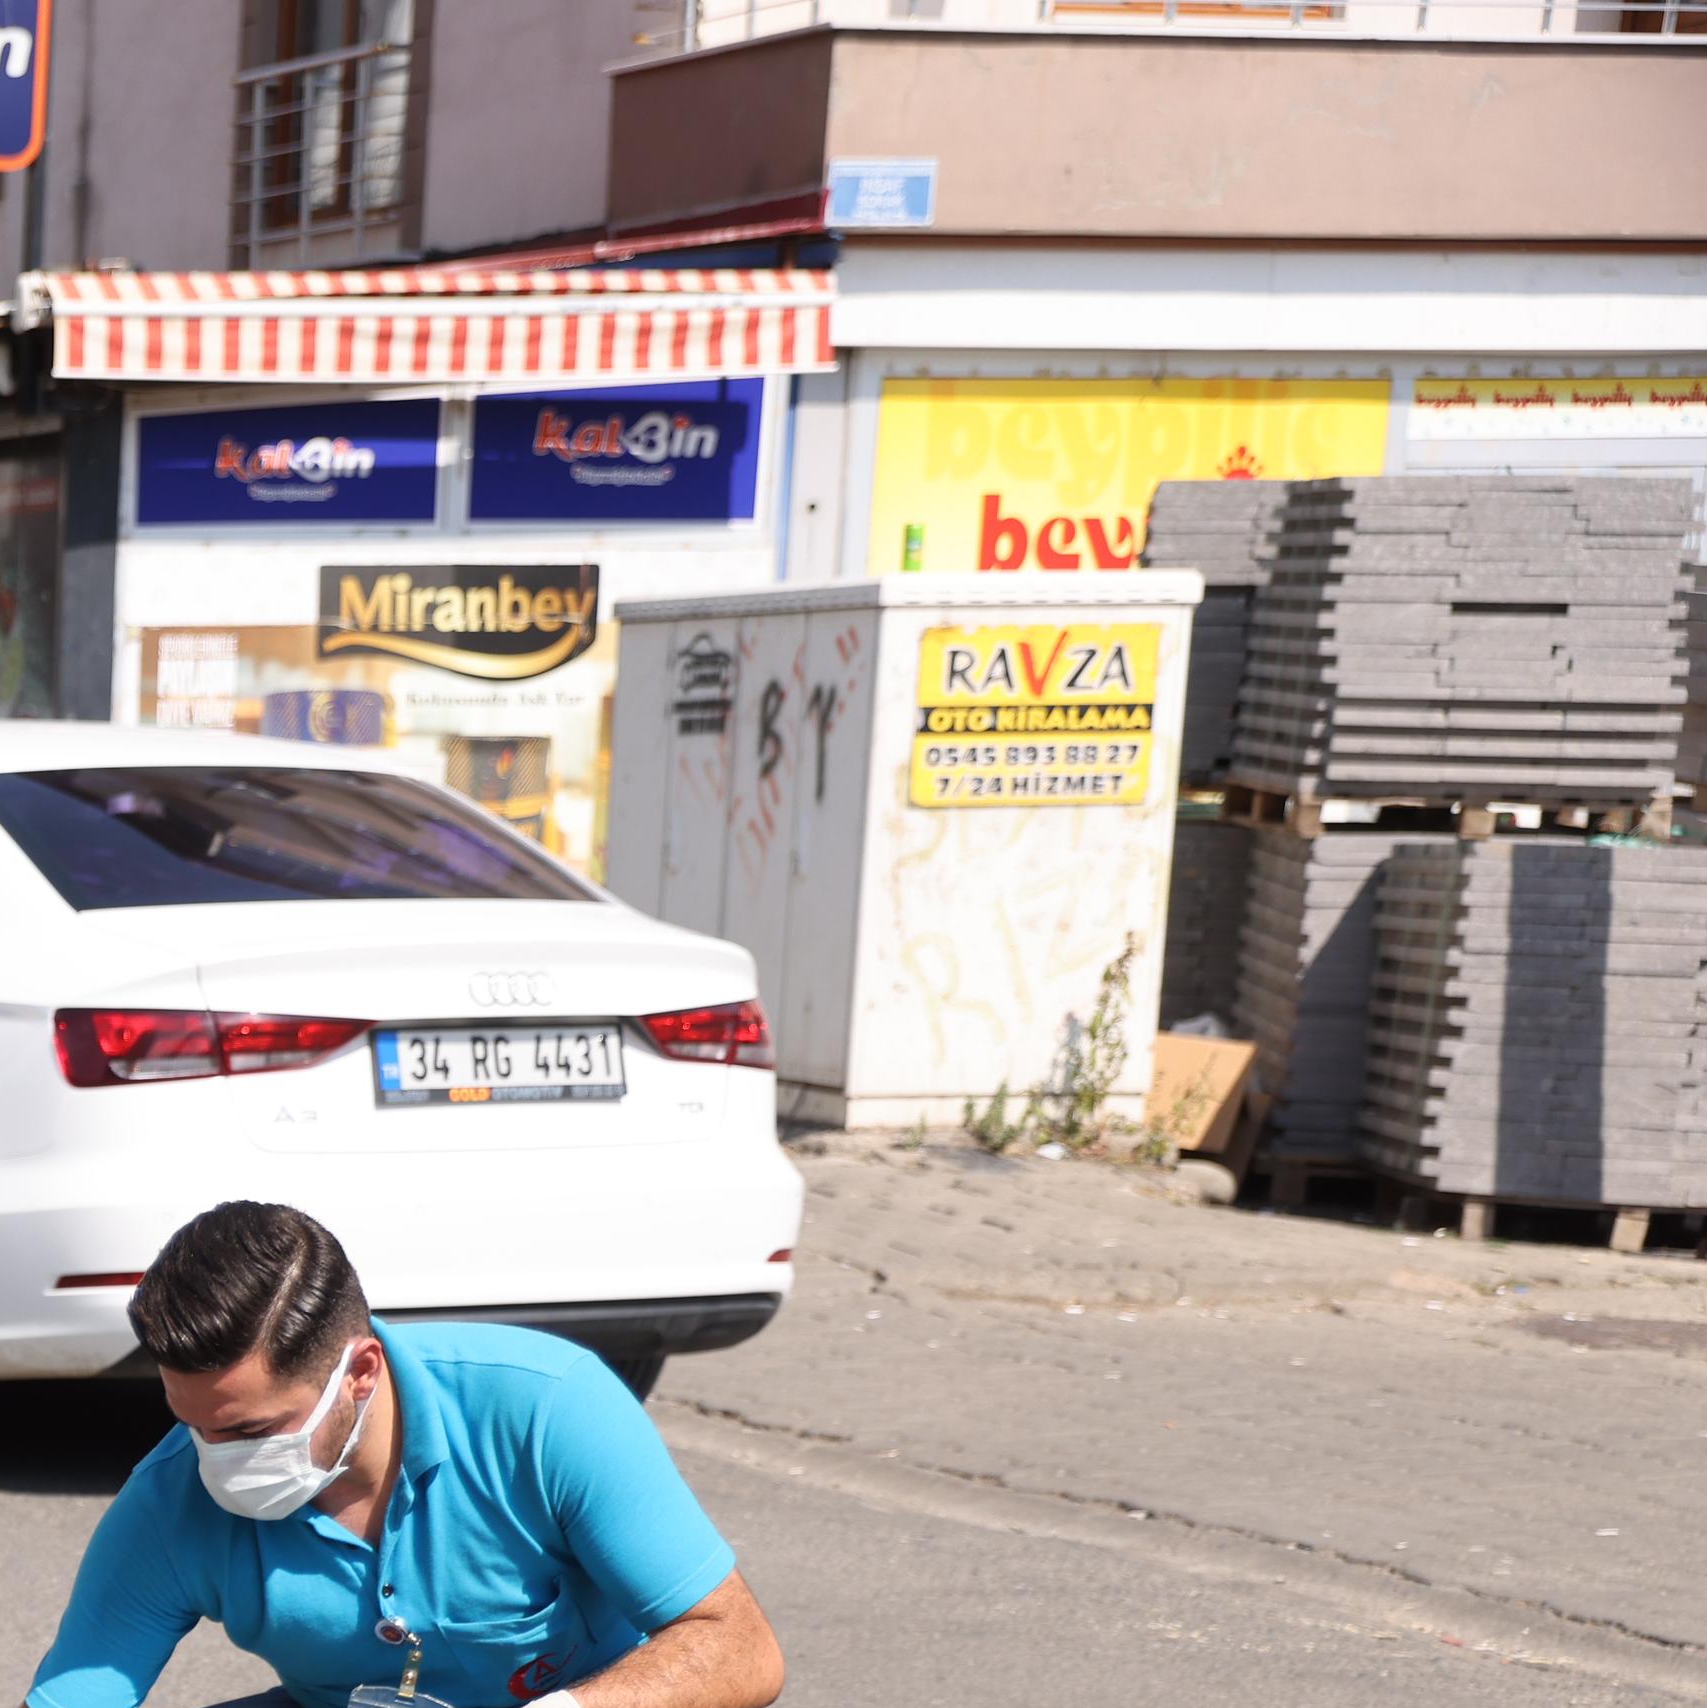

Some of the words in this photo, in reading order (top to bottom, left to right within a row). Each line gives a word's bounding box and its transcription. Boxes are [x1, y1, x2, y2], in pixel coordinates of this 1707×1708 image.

[337, 573, 597, 635] Miranbey
[947, 630, 1130, 699] RAVZA
[927, 707, 989, 732] OTO
[996, 705, 1150, 731] KİRALAMA
[926, 746, 996, 766] 0545
[1107, 744, 1139, 764] 27
[937, 776, 1003, 797] 7/24
[1012, 772, 1123, 795] HİZMET
[410, 1038, 449, 1081] 34
[473, 1036, 512, 1080] RG
[534, 1033, 613, 1077] 4431
[449, 1088, 491, 1103] GOLD
